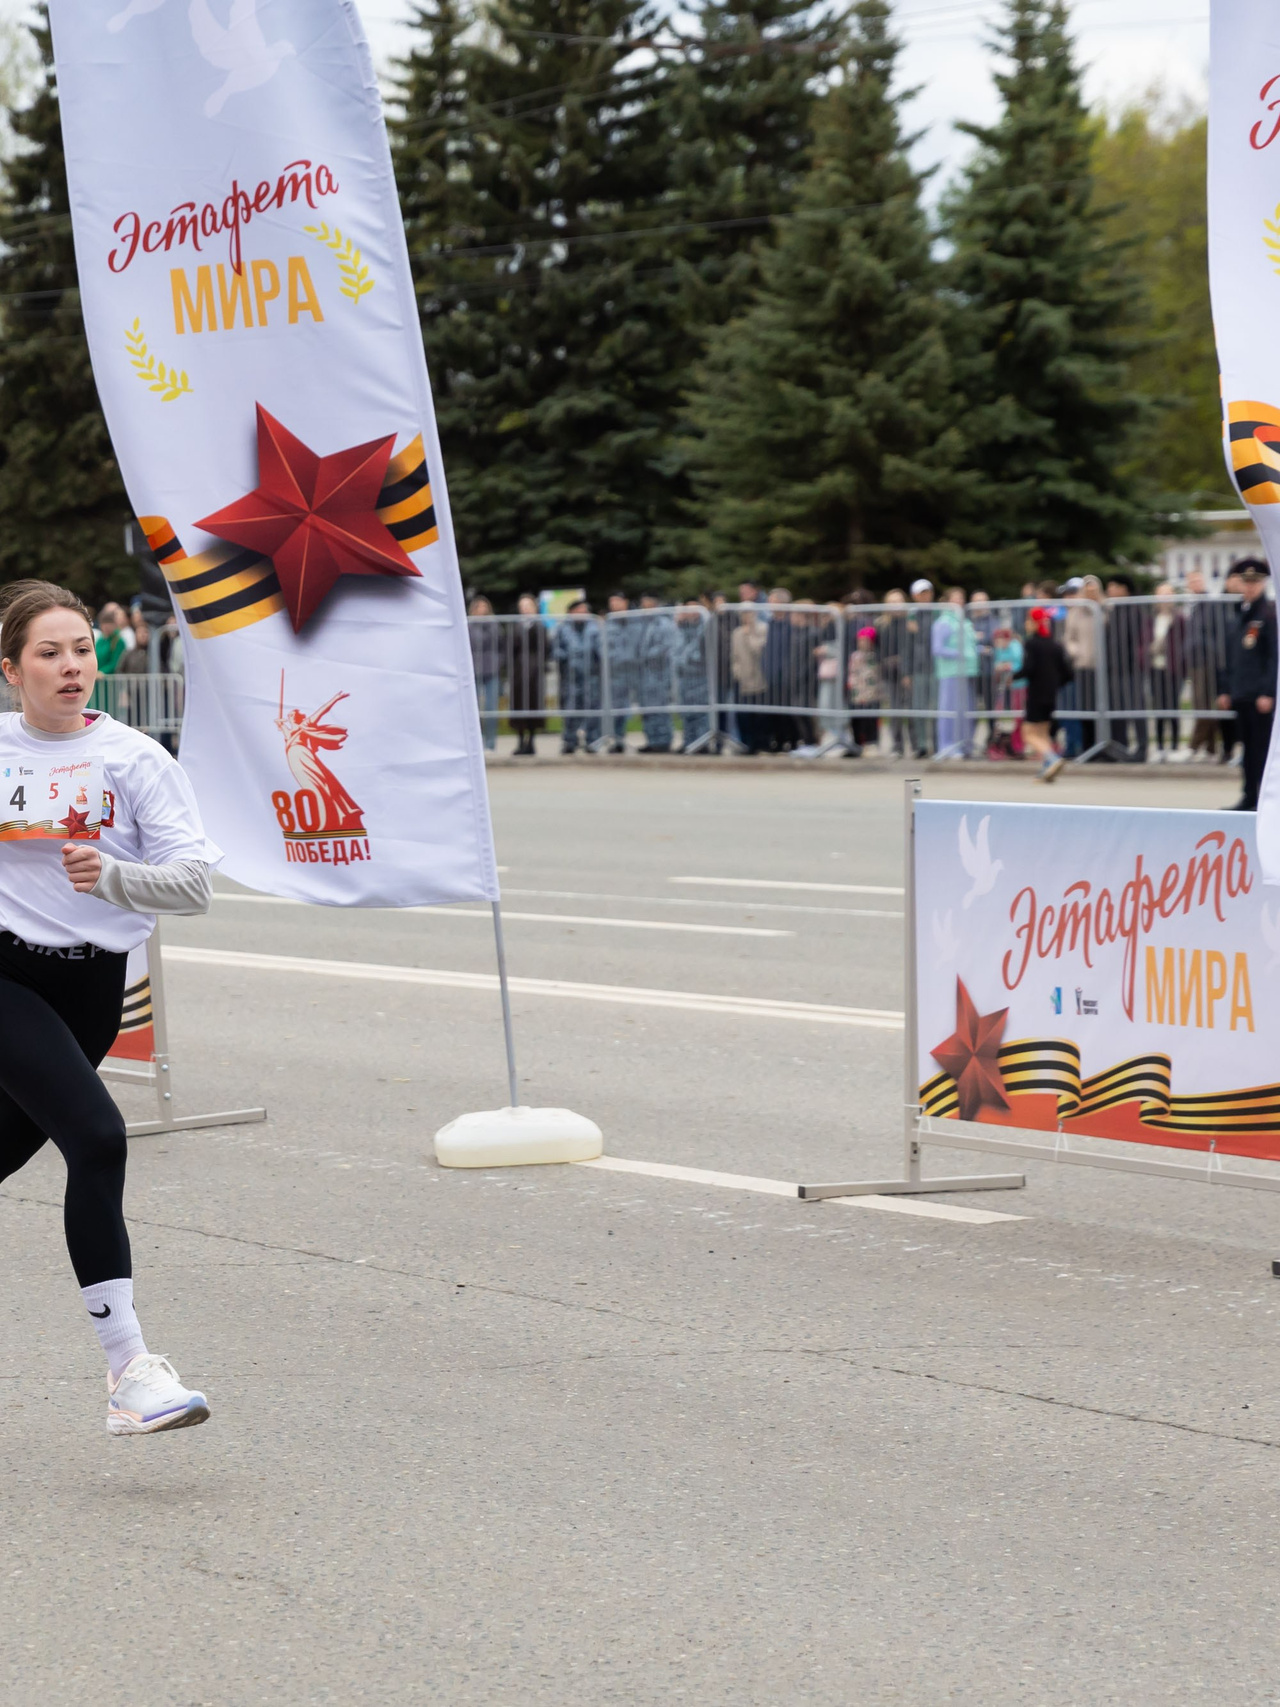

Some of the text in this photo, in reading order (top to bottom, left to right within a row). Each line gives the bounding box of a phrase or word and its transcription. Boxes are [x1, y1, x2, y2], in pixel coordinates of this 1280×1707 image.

[107, 159, 339, 274] Эстафета
[169, 255, 325, 335] МИРА
[9, 785, 27, 812] 4
[48, 782, 59, 800] 5
[271, 788, 322, 833] 80
[284, 838, 372, 866] ПОБЕДА!
[1001, 829, 1254, 1023] Эстафета
[1145, 945, 1256, 1033] МИРА
